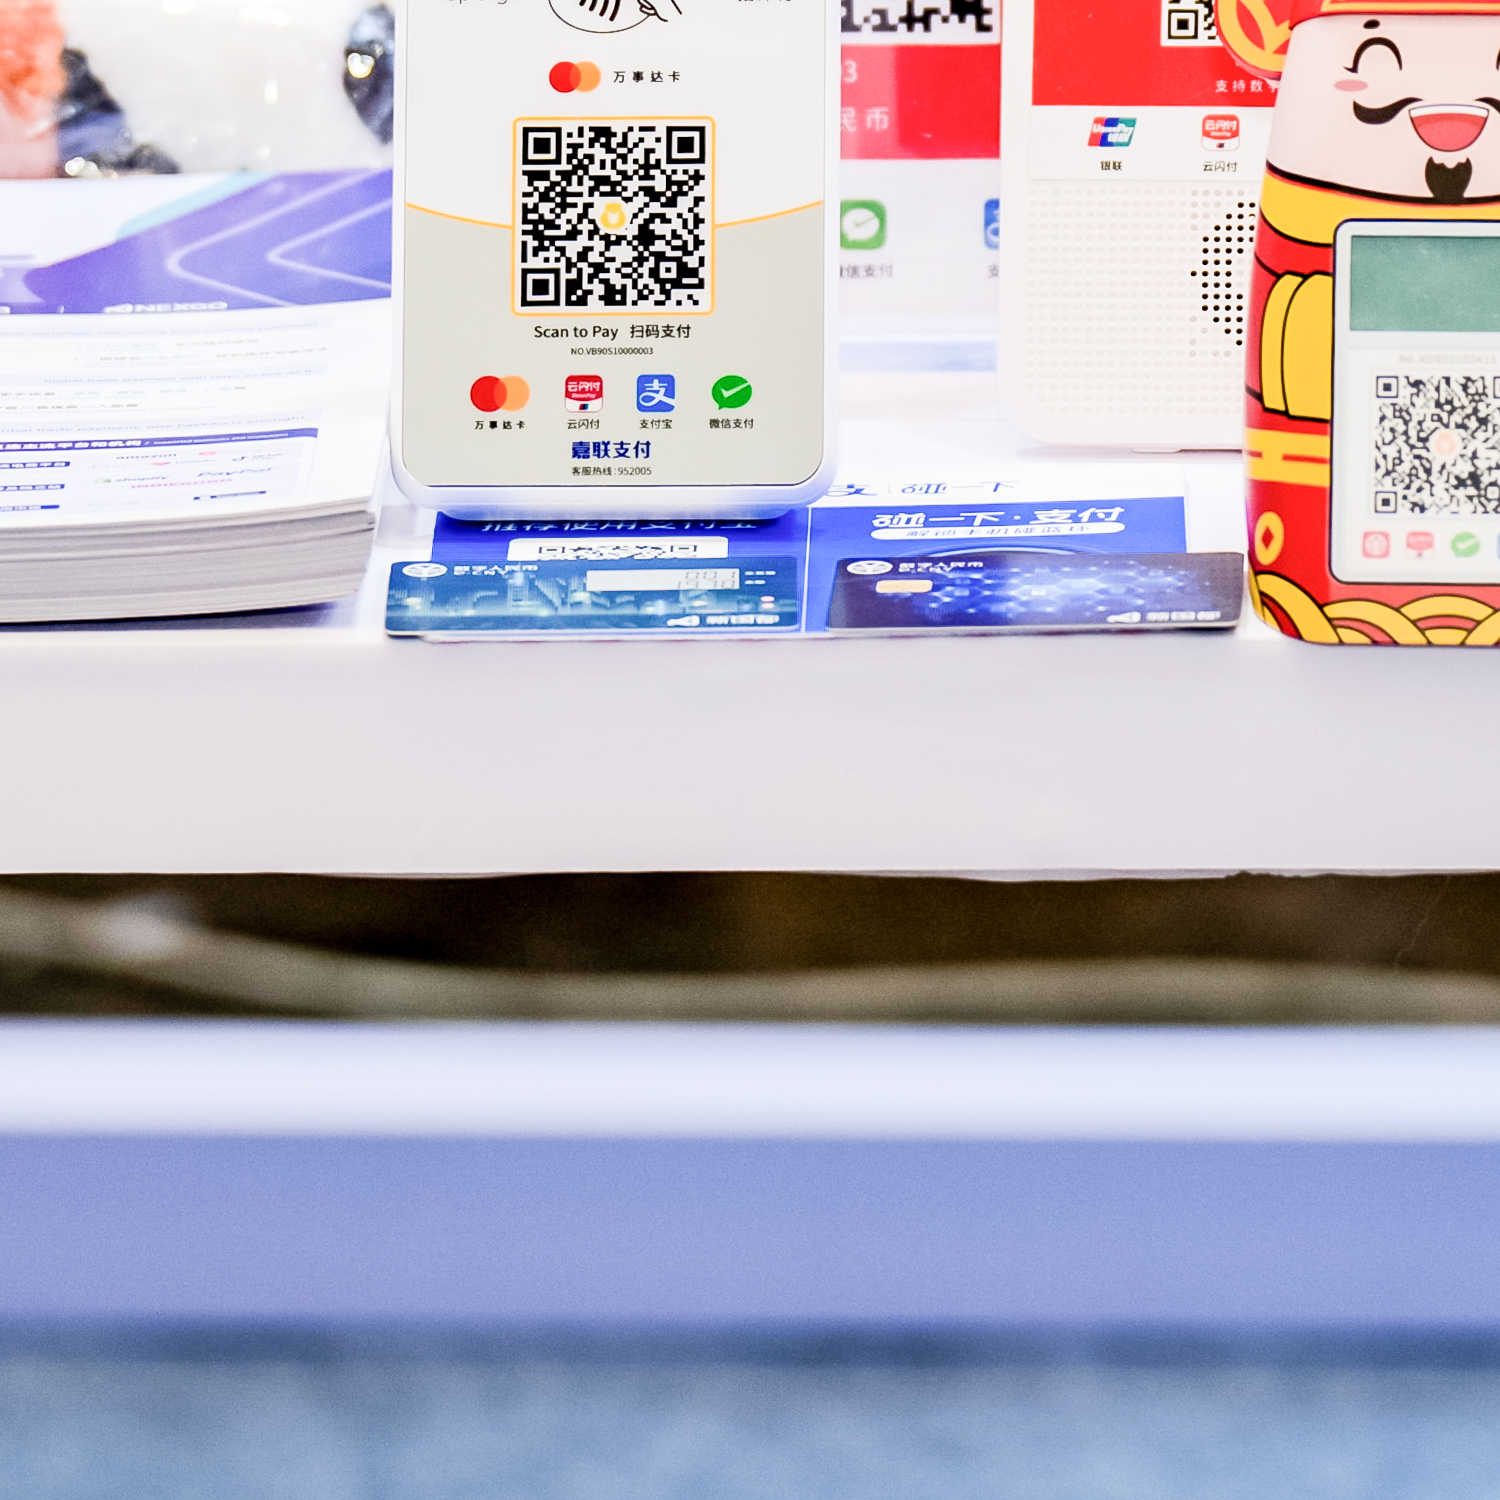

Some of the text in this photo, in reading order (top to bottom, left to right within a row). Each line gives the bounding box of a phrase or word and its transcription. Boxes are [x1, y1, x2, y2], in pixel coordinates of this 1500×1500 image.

[613, 70, 681, 83] 万事达卡
[1100, 160, 1123, 172] 银联
[1203, 160, 1238, 173] 云闪付
[534, 323, 692, 341] Scan to Pay 扫码支付
[567, 381, 601, 392] 云闪付
[475, 420, 526, 430] 万事达卡
[566, 418, 601, 430] 云闪付
[639, 418, 673, 430] 支付宝
[708, 418, 755, 430] 微信支付
[571, 440, 652, 459] 嘉联支付
[870, 505, 1126, 530] 碰一下·支付
